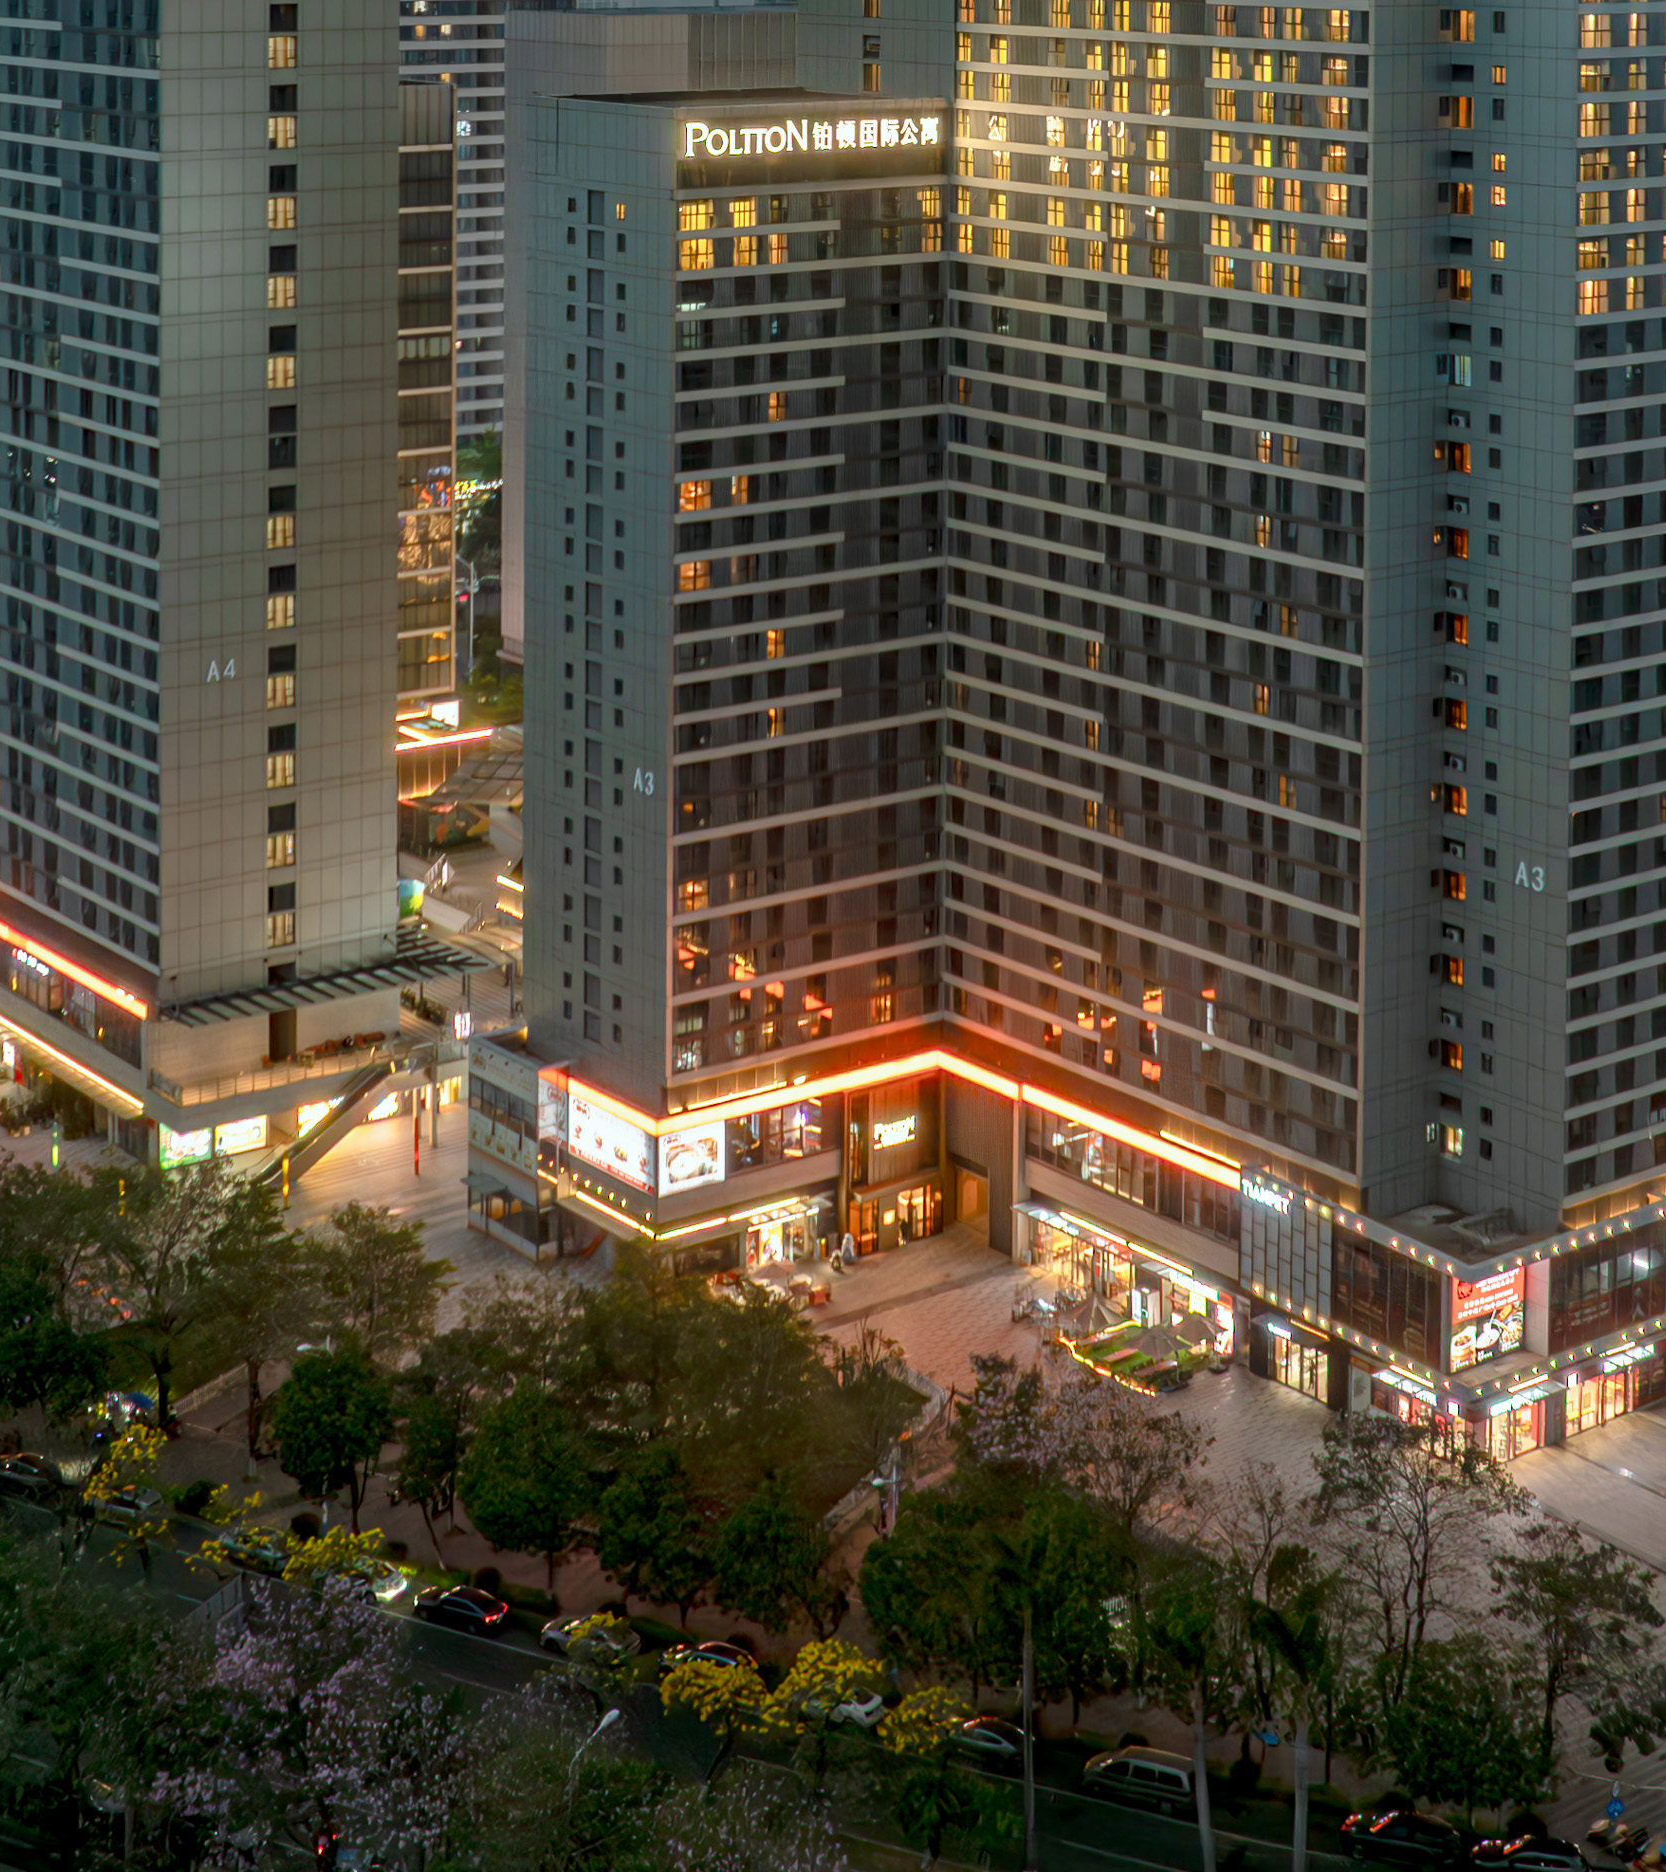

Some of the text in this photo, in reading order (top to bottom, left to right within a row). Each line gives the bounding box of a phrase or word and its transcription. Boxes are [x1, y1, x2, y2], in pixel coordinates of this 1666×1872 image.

[812, 116, 939, 151] 铂顿国际公寓
[206, 658, 236, 683] A4
[633, 767, 655, 796] A3
[1514, 860, 1546, 893] A3
